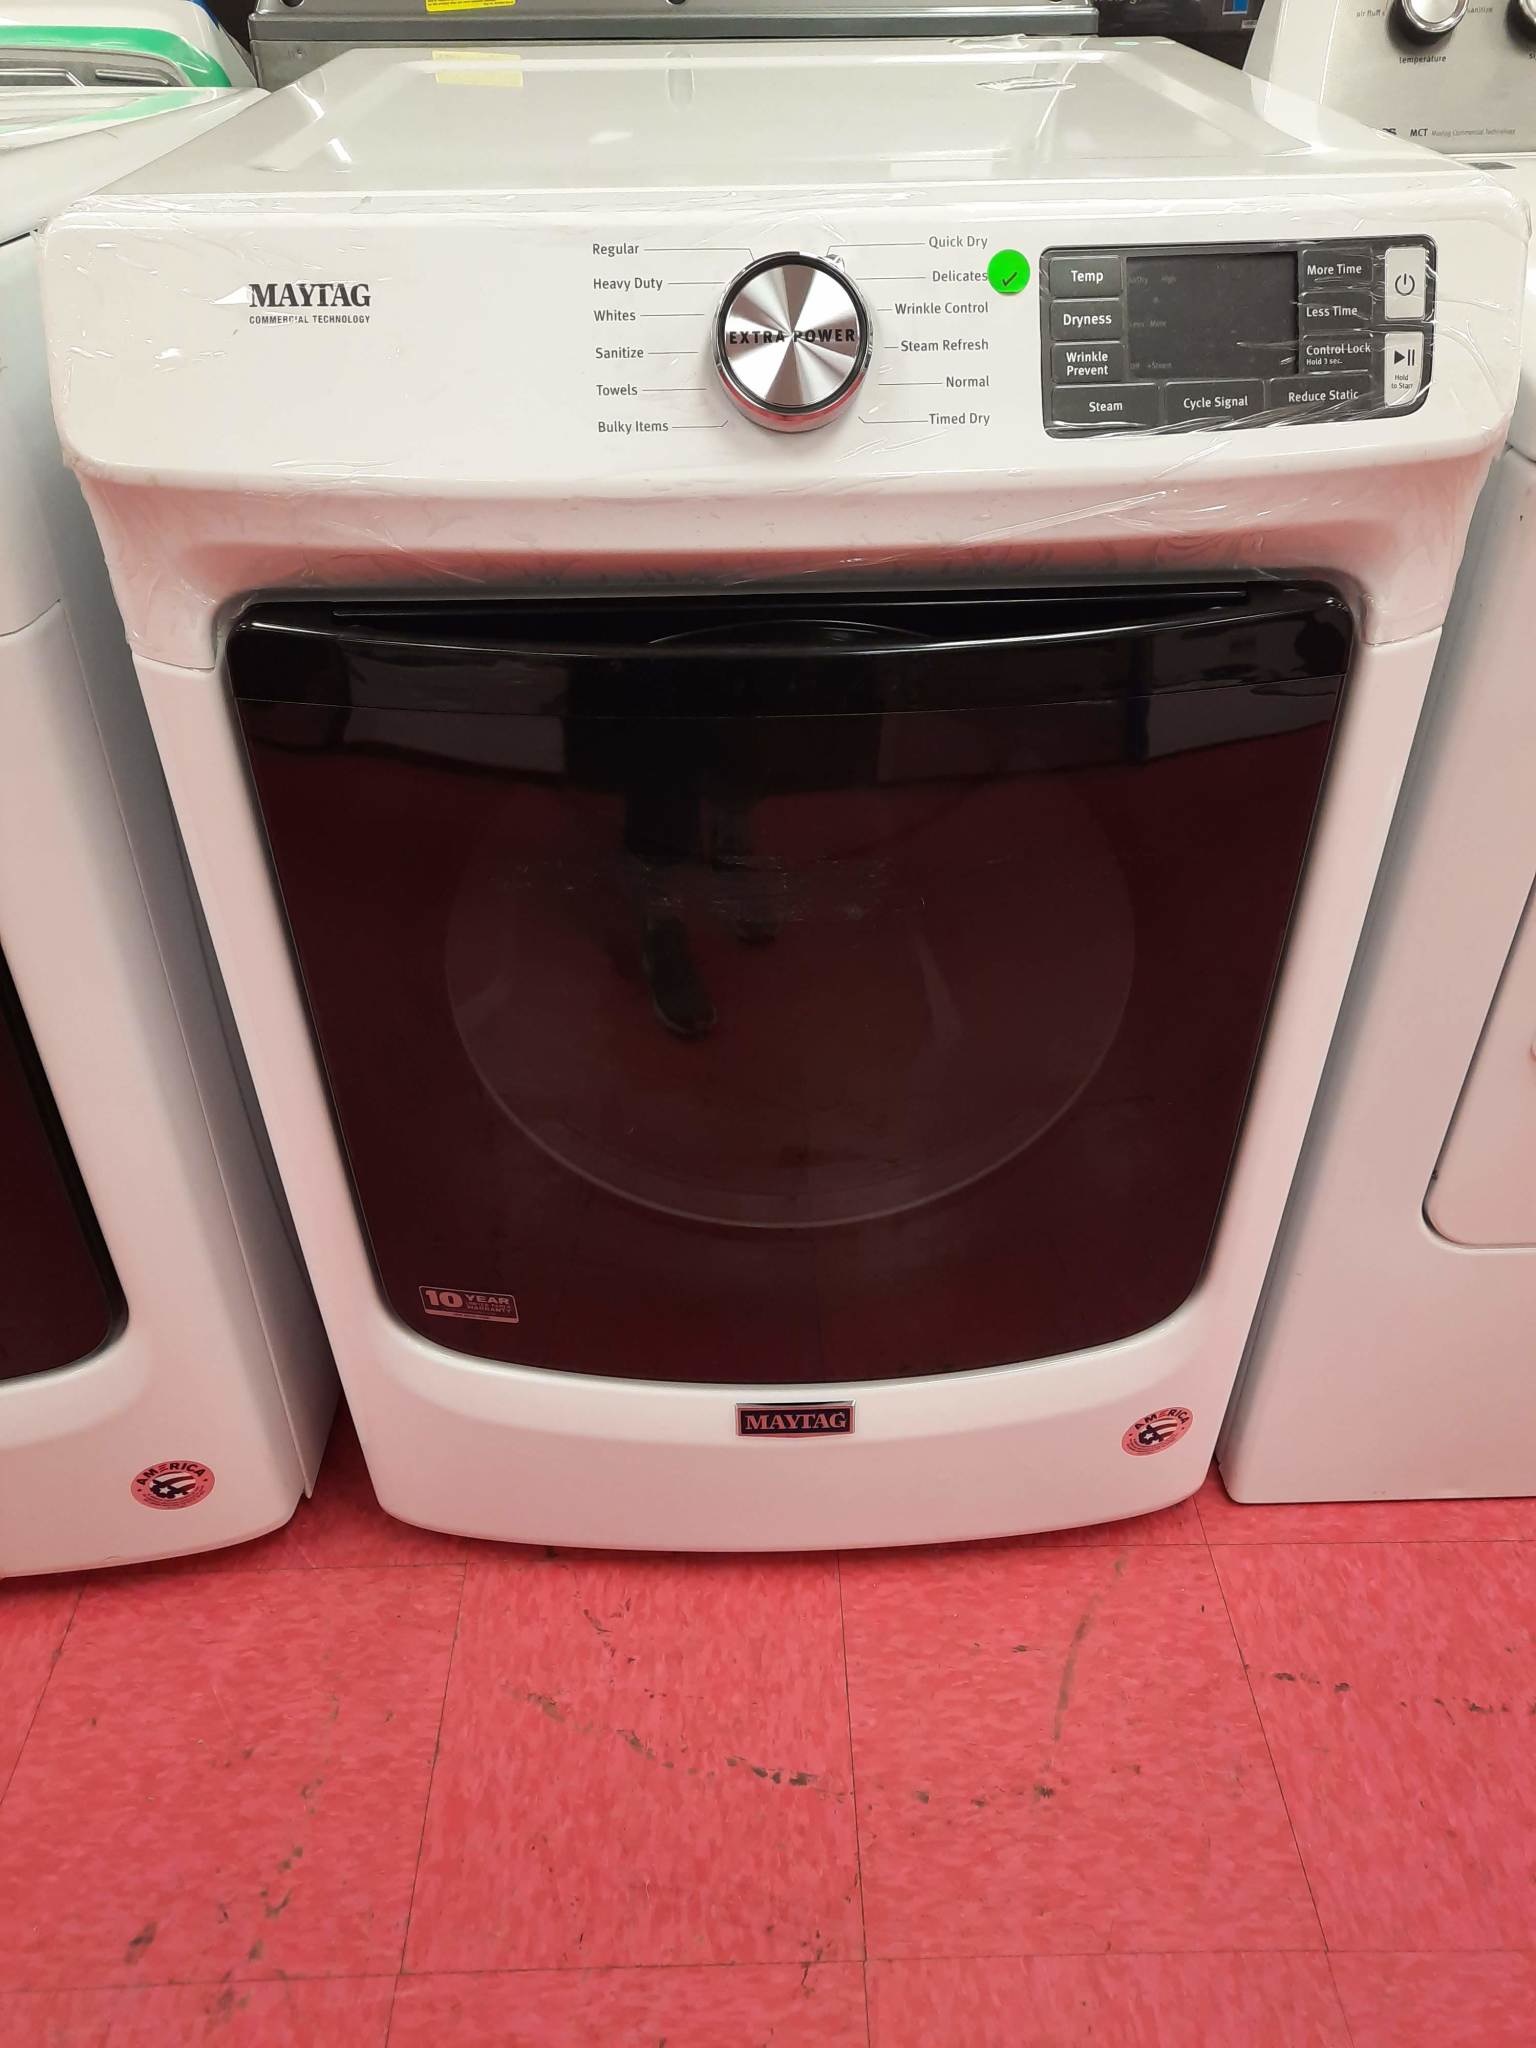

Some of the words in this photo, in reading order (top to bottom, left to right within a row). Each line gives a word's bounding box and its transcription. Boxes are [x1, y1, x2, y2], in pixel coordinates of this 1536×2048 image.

[1399, 55, 1447, 64] temperature
[1409, 128, 1429, 137] MCT
[928, 235, 964, 249] Quick
[966, 235, 988, 249] Dry
[592, 242, 640, 257] Regular
[932, 270, 988, 282] Delicates
[1306, 264, 1335, 276] More
[1336, 263, 1363, 275] Time
[1070, 270, 1104, 284] Temp
[593, 278, 631, 292] Heavy
[634, 277, 664, 291] Duty
[248, 283, 371, 307] MAYTAG
[593, 309, 636, 321] Whites
[894, 302, 942, 315] Wrinkle
[944, 301, 989, 314] Control
[1306, 306, 1330, 317] Less
[1332, 305, 1359, 316] Time
[312, 315, 370, 324] TECHNOLOGY
[1063, 313, 1113, 328] Dryness
[729, 330, 785, 345] EXTRA
[792, 328, 856, 343] POWER
[900, 340, 939, 352] Steam
[942, 338, 989, 351] Refresh
[1306, 344, 1345, 356] Control
[1347, 342, 1371, 354] Lock
[595, 346, 645, 359] Sanitize
[1066, 351, 1109, 363] Wrinkle
[1066, 365, 1109, 376] Prevent
[945, 375, 990, 388] Normal
[596, 384, 638, 396] Towels
[1288, 391, 1327, 403] Reduce
[1329, 389, 1359, 401] Static
[1088, 401, 1123, 413] Steam
[1183, 397, 1212, 411] Cycle
[1214, 395, 1249, 409] Signal
[929, 412, 966, 425] Timed
[968, 412, 991, 426] Dry
[597, 421, 631, 435] Bulky
[635, 421, 669, 432] Items
[425, 1289, 463, 1308] 10
[464, 1294, 510, 1305] YEAR
[744, 1411, 847, 1430] MAYTAG
[1134, 1408, 1190, 1430] AMERICA
[136, 1462, 206, 1486] AMERICA
